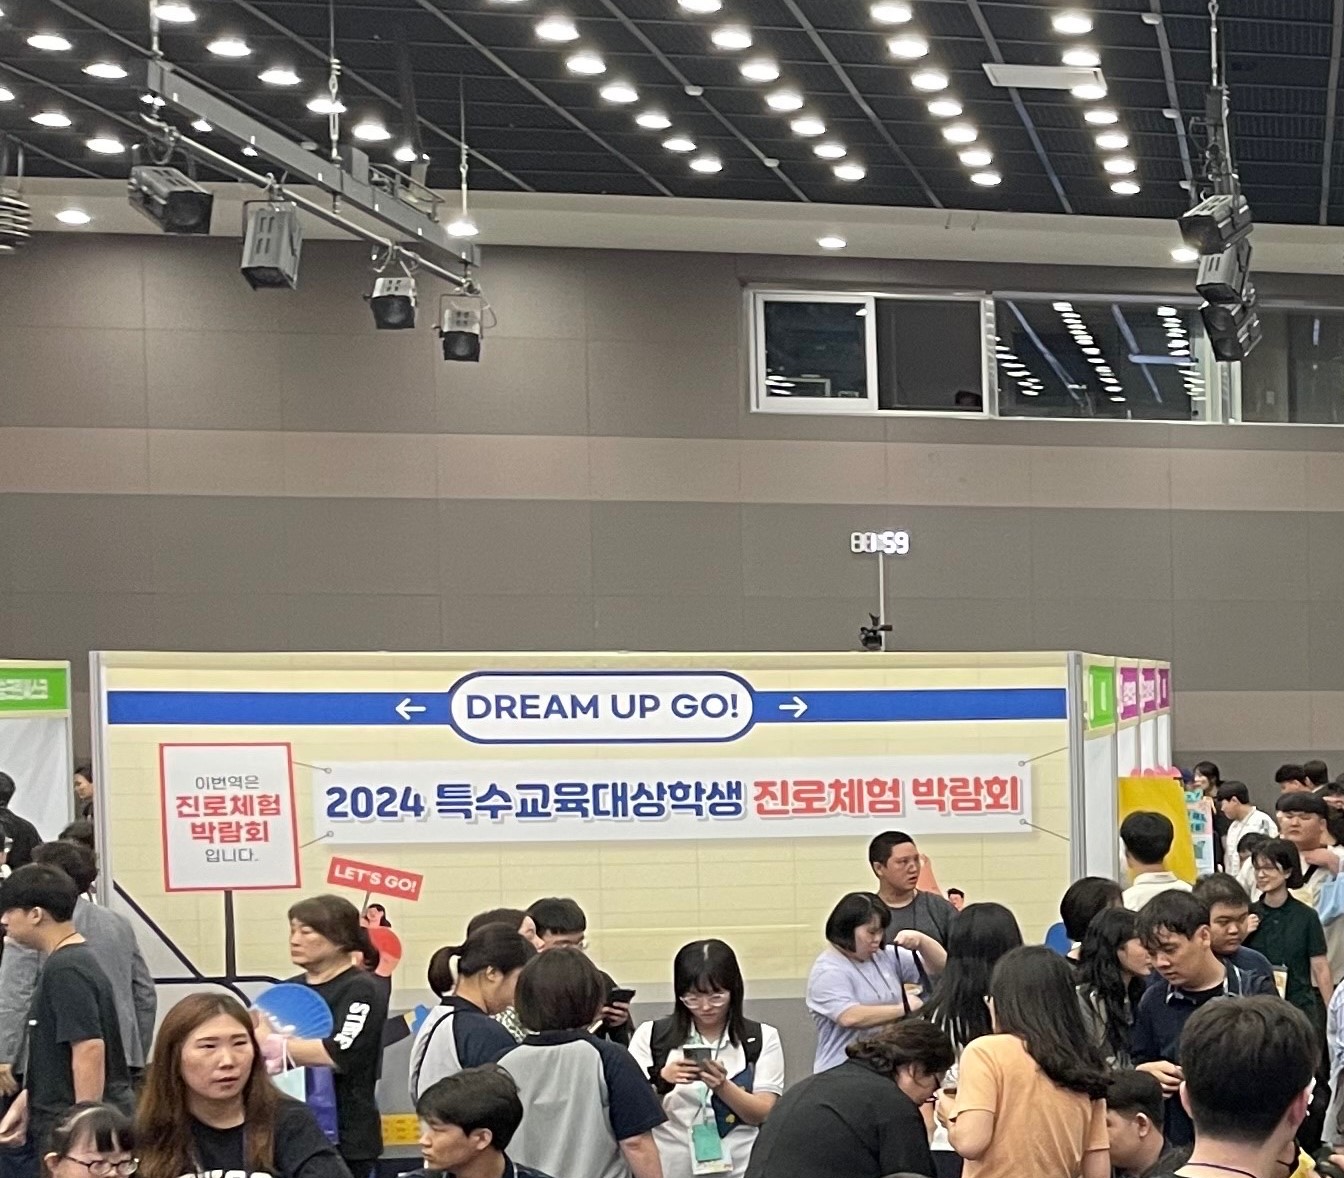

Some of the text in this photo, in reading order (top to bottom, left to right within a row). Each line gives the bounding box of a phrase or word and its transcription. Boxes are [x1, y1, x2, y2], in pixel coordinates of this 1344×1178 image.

[467, 692, 739, 721] DREAM UP GO!
[195, 774, 260, 791] 이번역은
[175, 794, 281, 818] 진로체험
[325, 775, 1020, 820] 2024 특수교육대상학생 진로체험 박람회
[190, 820, 269, 844] 박람회
[205, 848, 259, 863] 입니다.
[334, 865, 417, 894] LET'S GO!
